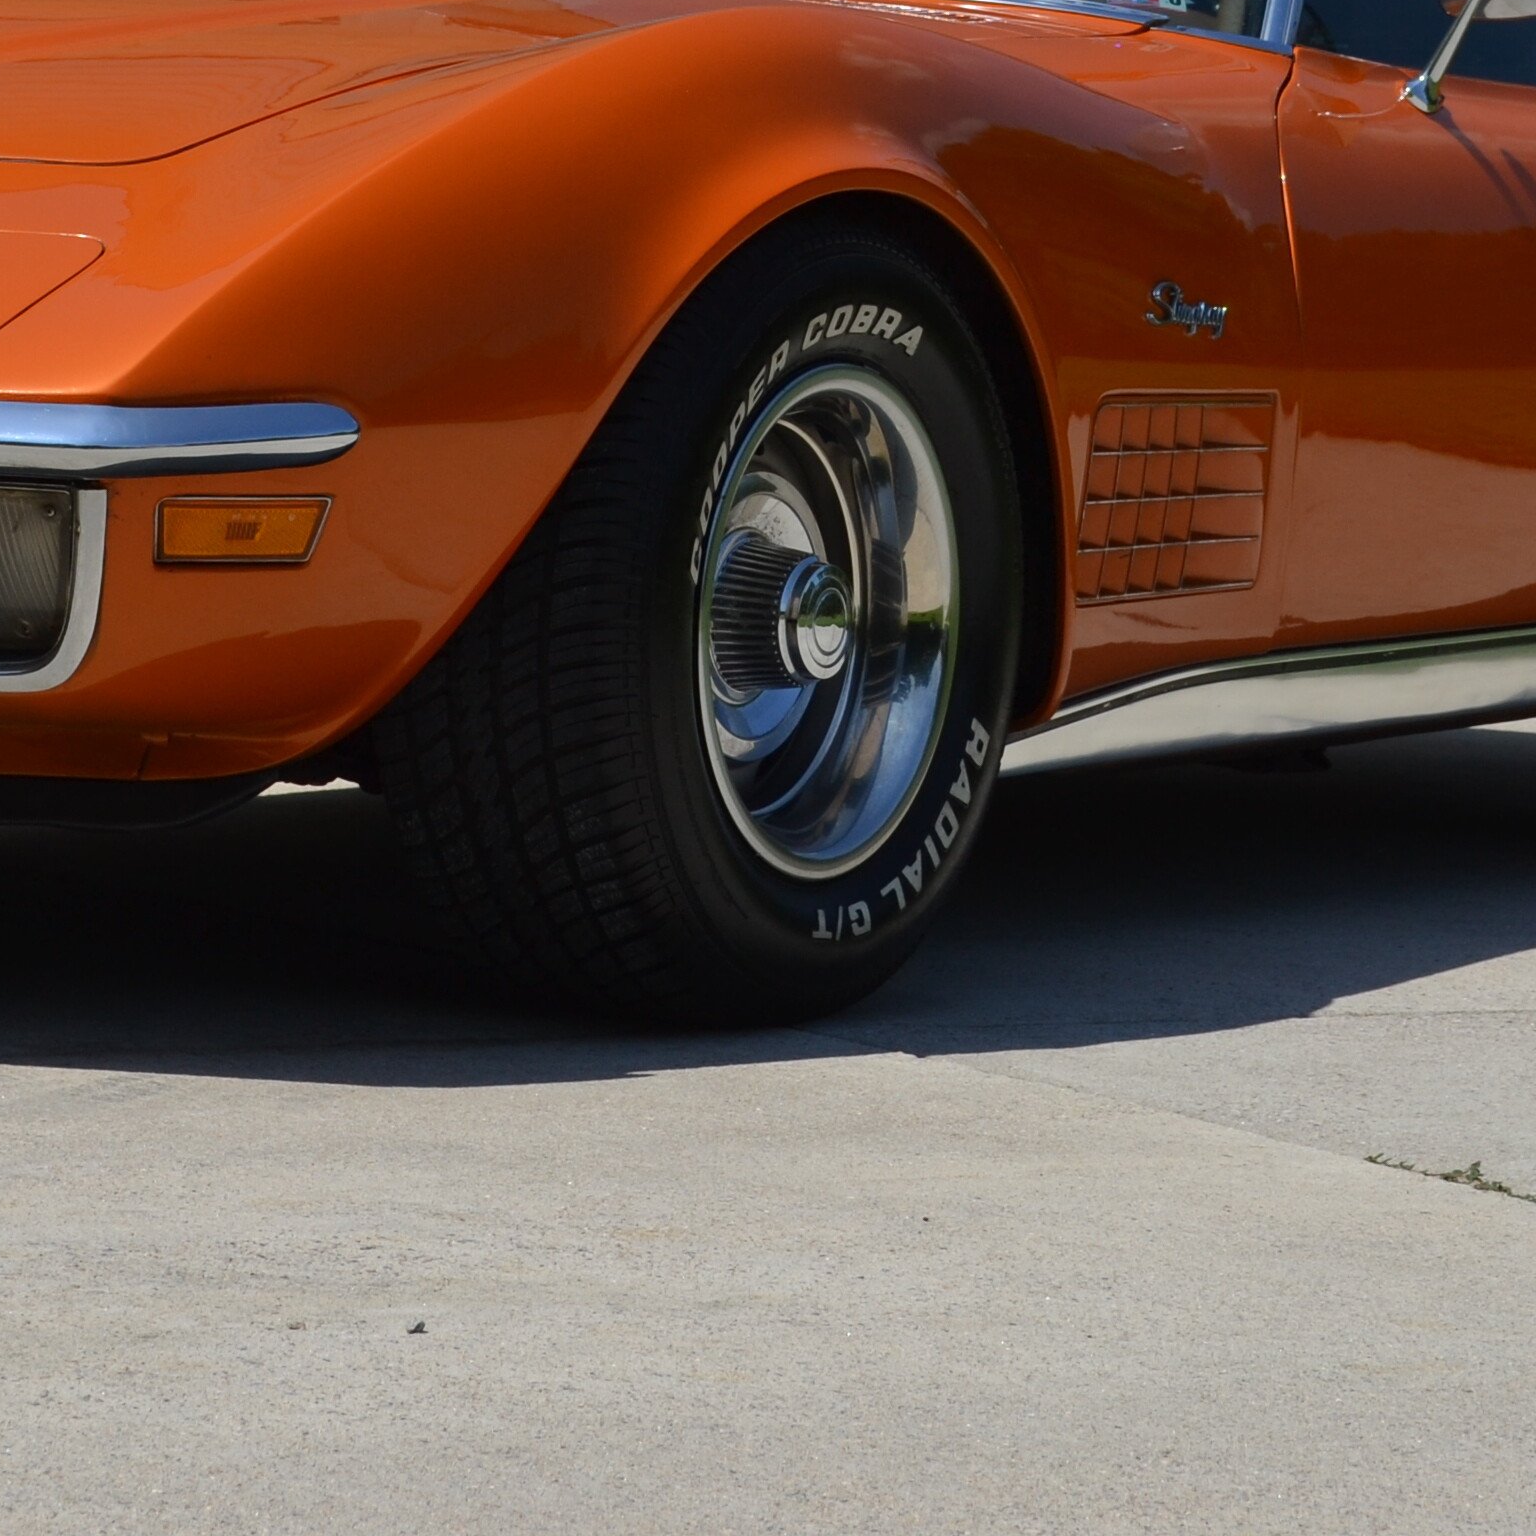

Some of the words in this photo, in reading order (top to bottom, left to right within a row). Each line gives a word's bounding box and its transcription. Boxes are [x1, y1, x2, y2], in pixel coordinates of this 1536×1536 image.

[690, 339, 790, 585] COOPER
[801, 304, 924, 357] COBRA
[879, 716, 991, 912] RADIAL
[811, 899, 872, 941] G/T
